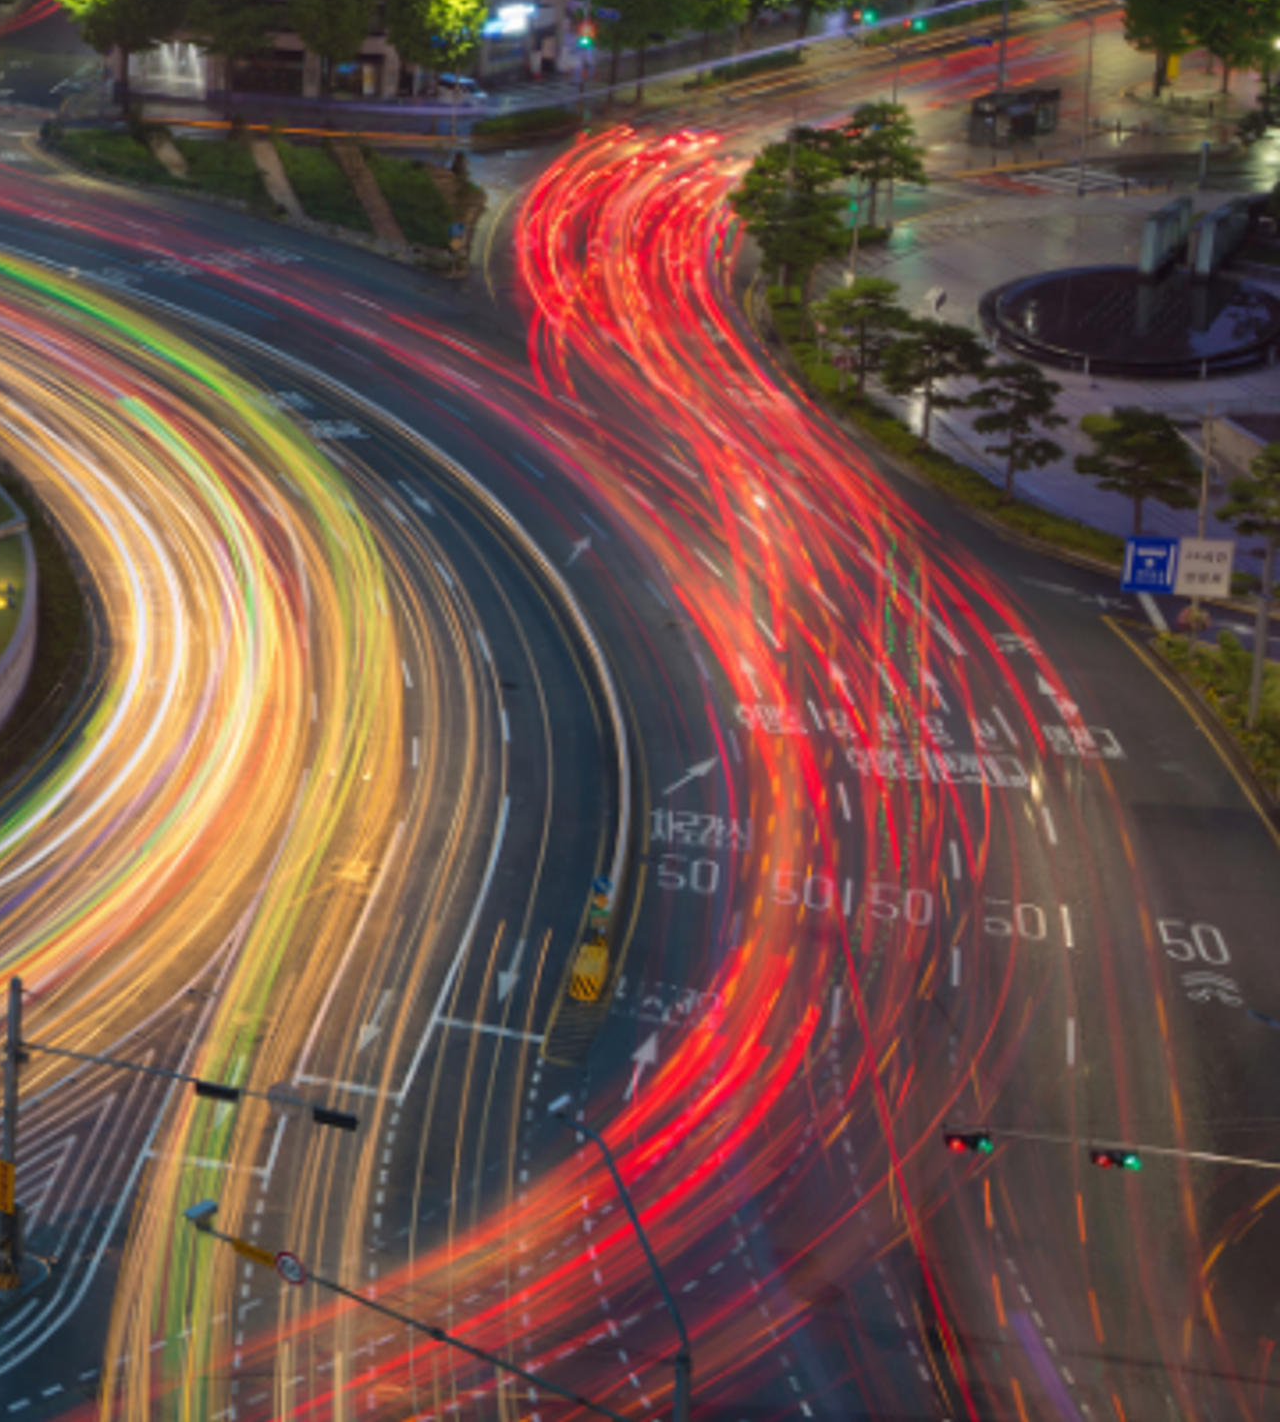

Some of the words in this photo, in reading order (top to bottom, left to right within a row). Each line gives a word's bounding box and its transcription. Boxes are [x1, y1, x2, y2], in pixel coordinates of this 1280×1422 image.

[657, 854, 719, 894] 50
[772, 869, 833, 911] 50
[871, 881, 933, 926] 50
[984, 895, 1047, 940] 50
[1157, 918, 1230, 965] 50
